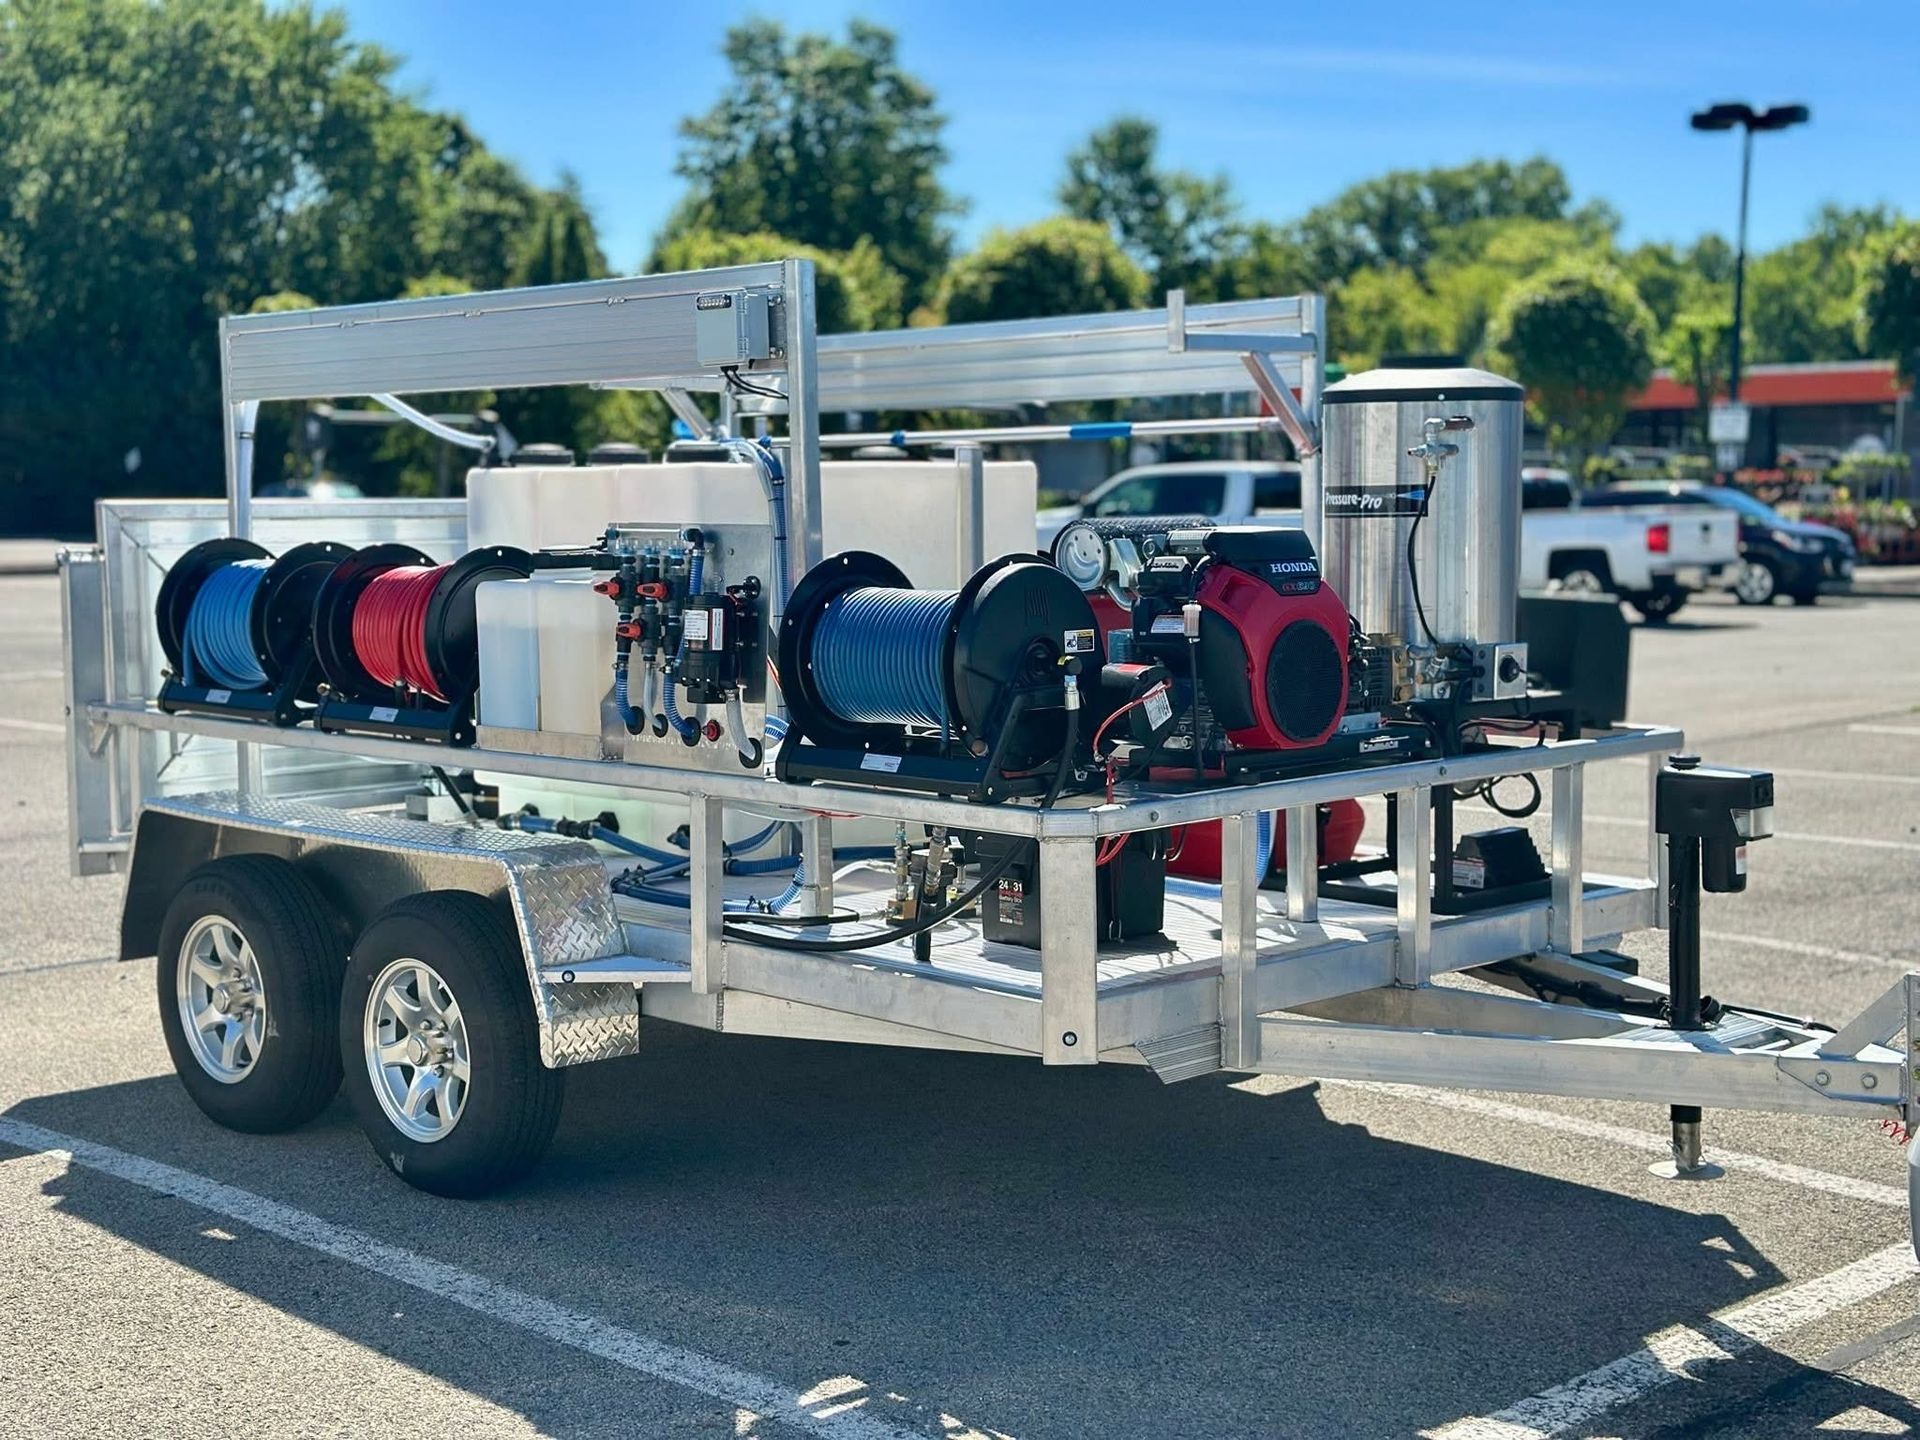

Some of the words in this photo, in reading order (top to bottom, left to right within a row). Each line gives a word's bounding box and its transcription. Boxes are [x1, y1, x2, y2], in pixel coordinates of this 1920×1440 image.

[1270, 562, 1317, 573] HONDA
[998, 879, 1009, 890] 24
[1013, 882, 1023, 892] 31
